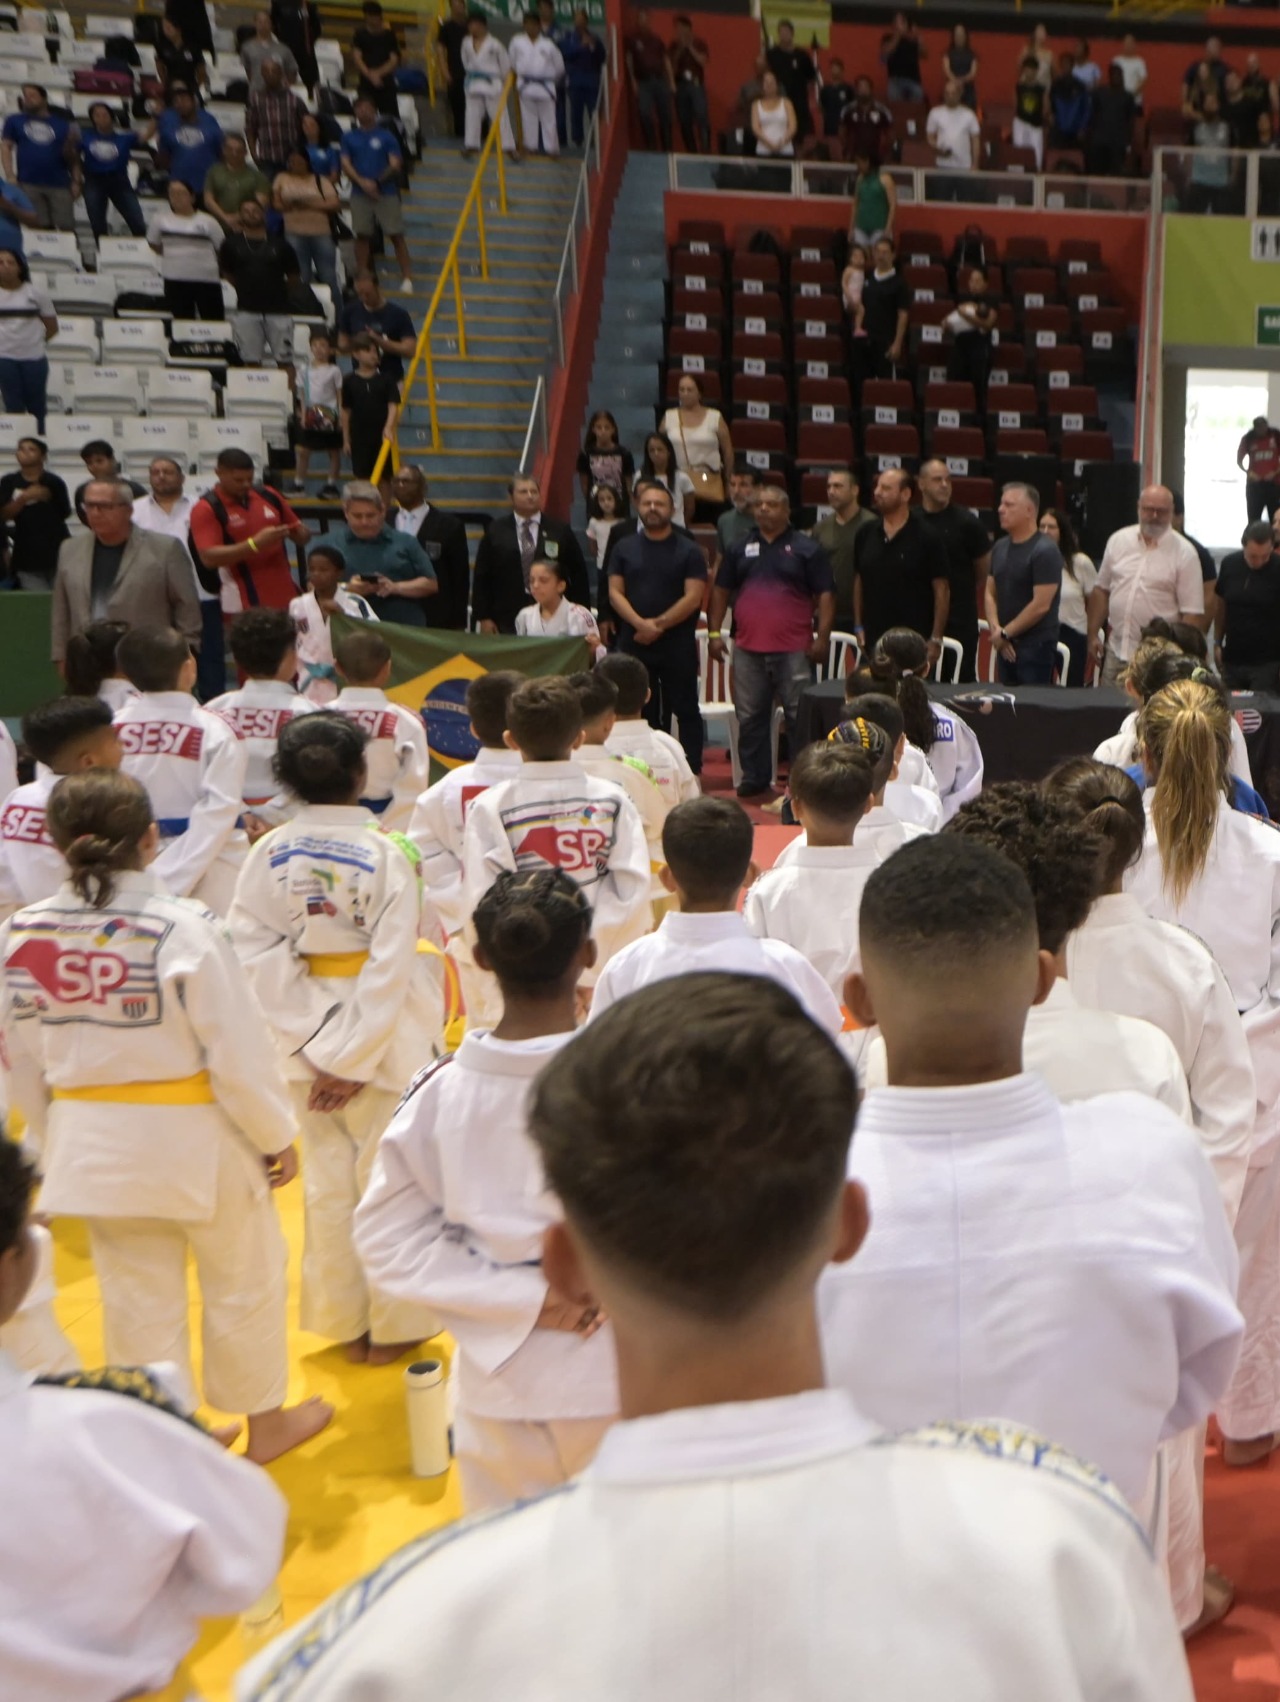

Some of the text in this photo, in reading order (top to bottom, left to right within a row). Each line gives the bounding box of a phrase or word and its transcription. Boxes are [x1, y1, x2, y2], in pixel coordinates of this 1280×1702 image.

[119, 723, 190, 754] SESI
[557, 831, 605, 869] SP
[57, 953, 124, 1000] SP
